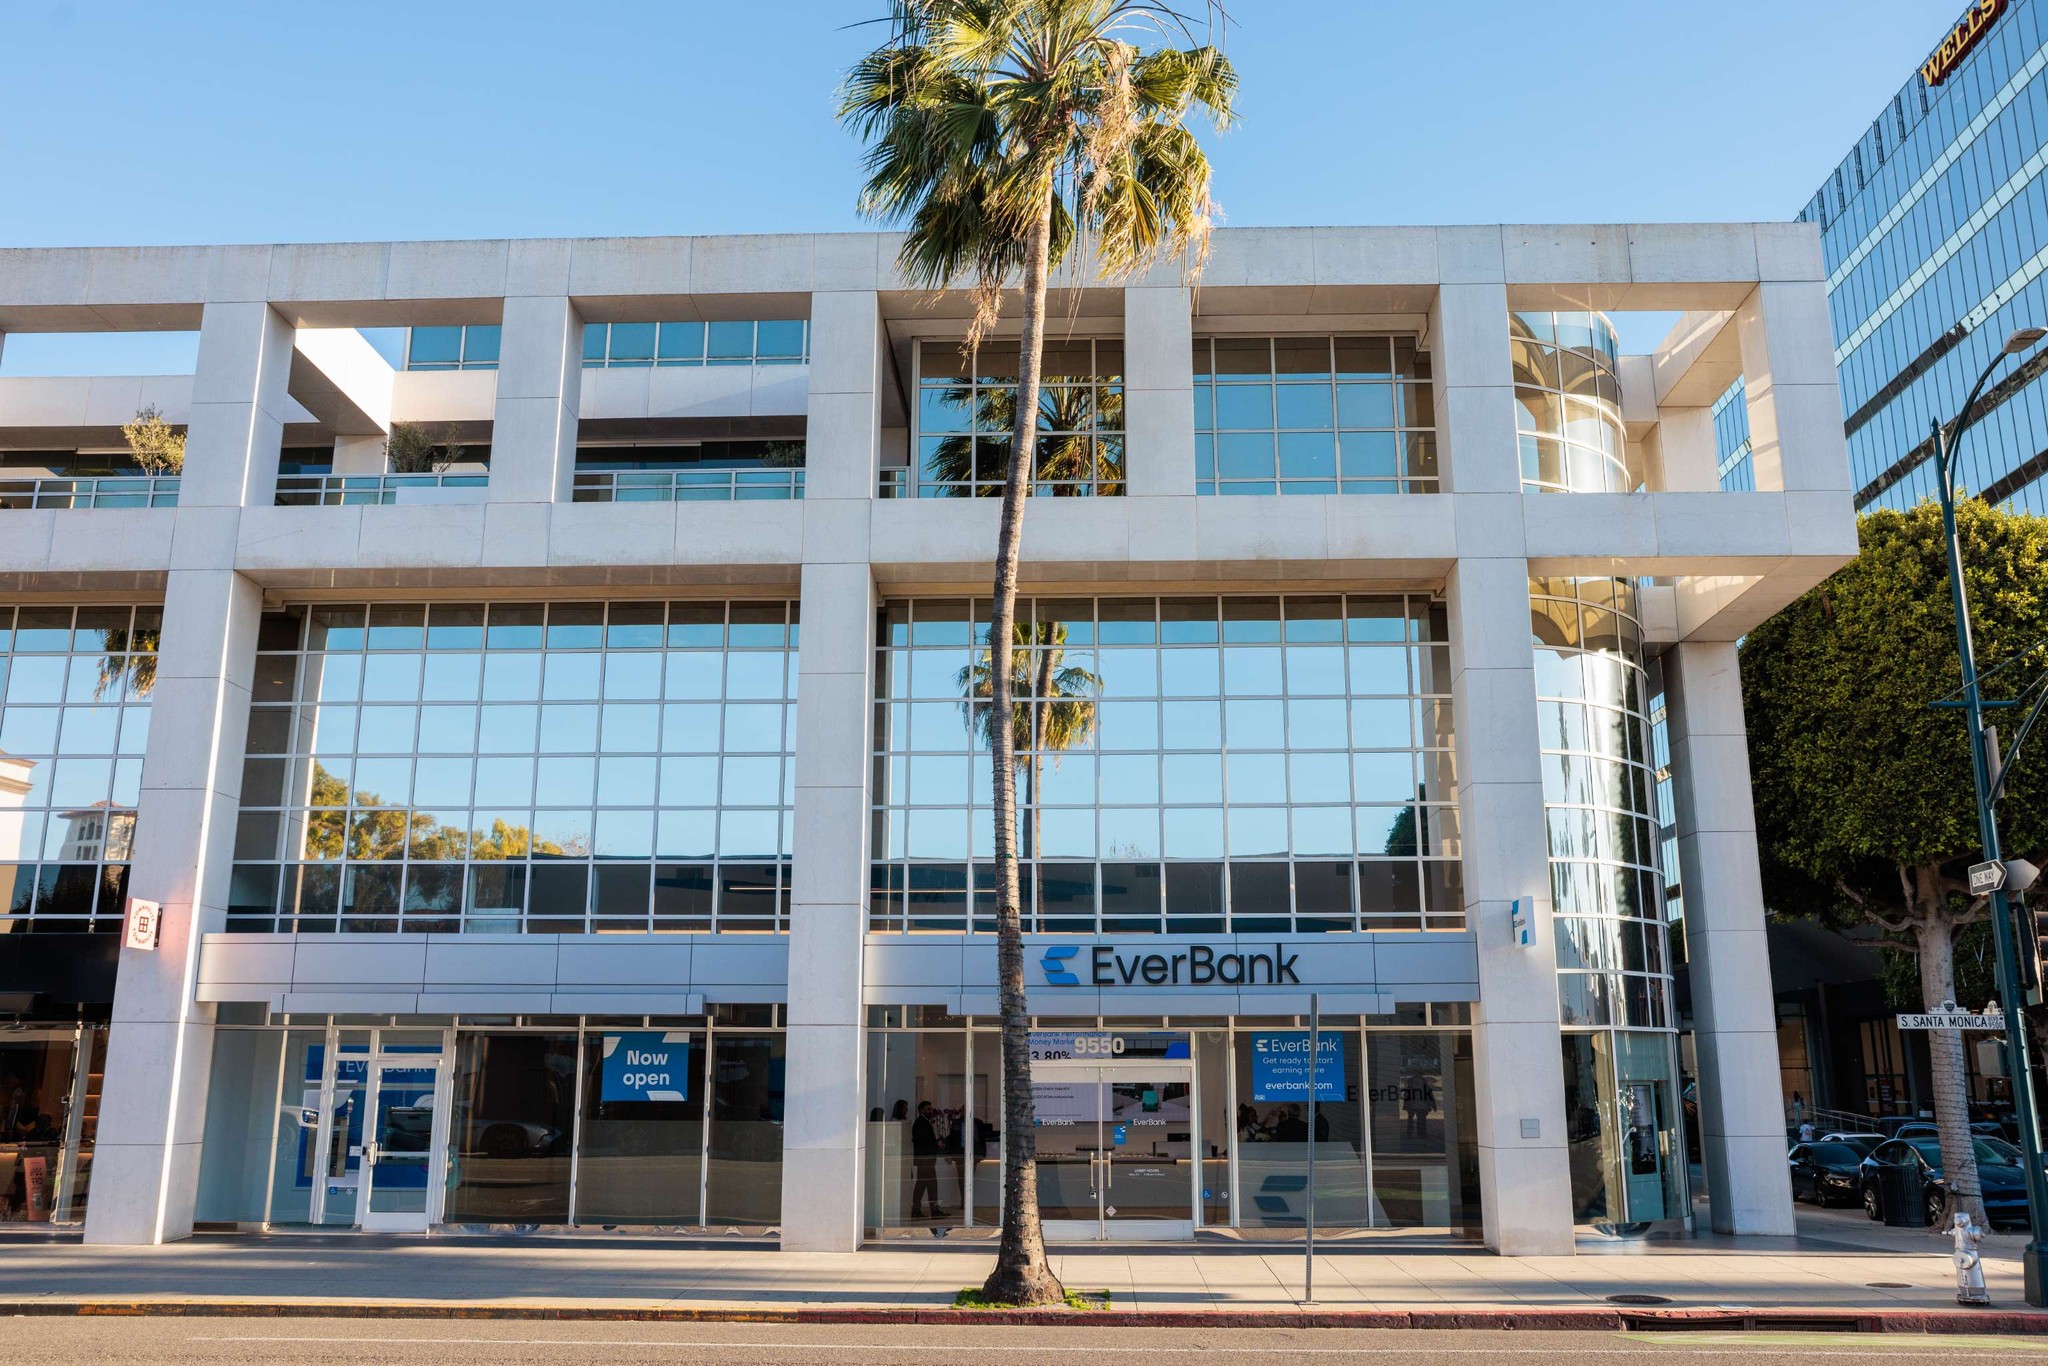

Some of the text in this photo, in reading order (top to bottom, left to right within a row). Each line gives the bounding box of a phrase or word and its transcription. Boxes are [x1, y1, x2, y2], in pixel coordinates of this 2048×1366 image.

[1921, 0, 1997, 86] WELLS
[1973, 870, 1995, 885] ONE WAY
[1092, 943, 1300, 985] EverBank
[1902, 1016, 1988, 1027] S. SANTA MONICA
[1074, 1037, 1125, 1054] 9550
[1271, 1038, 1337, 1052] EverBnk
[626, 1050, 669, 1066] Now
[1031, 1050, 1072, 1059] 380%
[1280, 1057, 1301, 1065] ready
[1272, 1066, 1302, 1075] earning
[622, 1073, 670, 1090] open
[1265, 1081, 1333, 1090] everbankcom
[1347, 1083, 1433, 1102] EerBank
[1042, 1118, 1076, 1126] EverBank
[1133, 1118, 1167, 1126] EverBank
